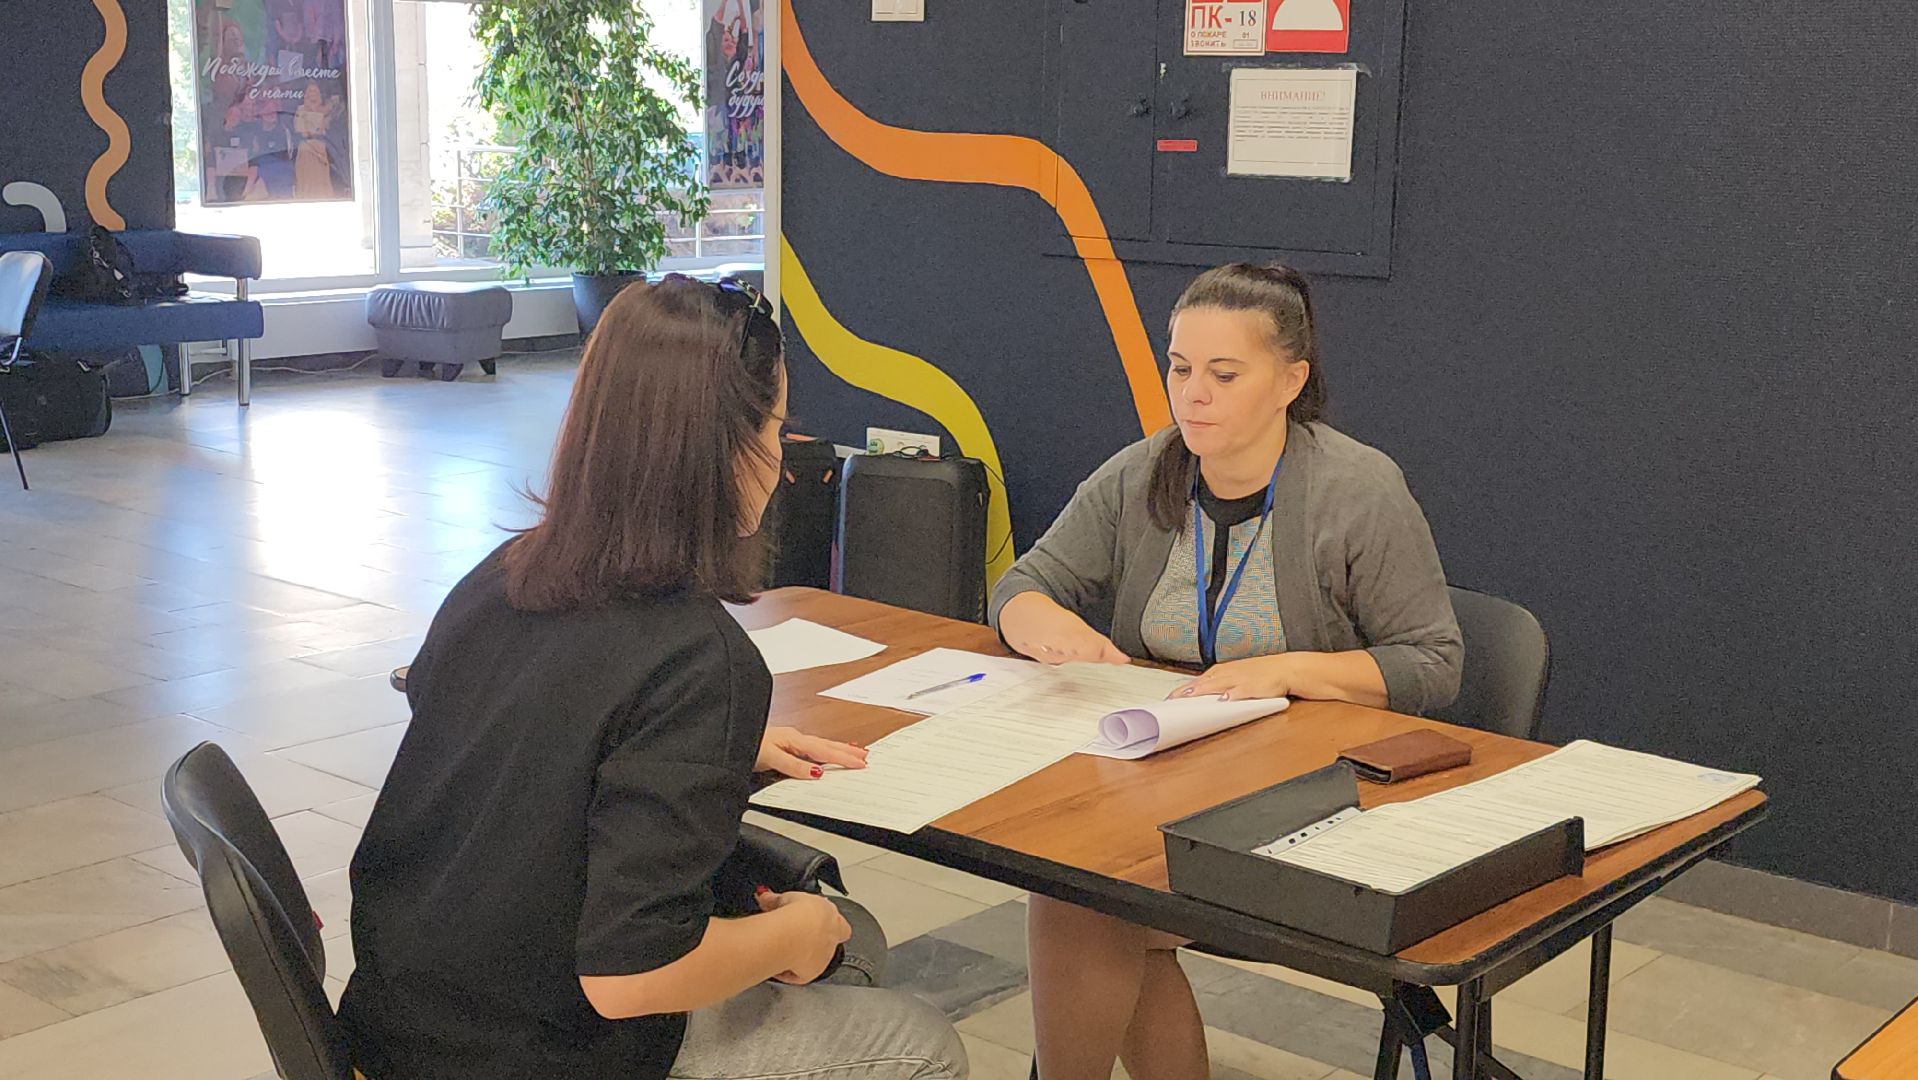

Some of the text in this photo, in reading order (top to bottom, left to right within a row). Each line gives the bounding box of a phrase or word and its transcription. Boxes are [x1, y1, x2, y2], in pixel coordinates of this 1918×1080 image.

[1239, 10, 1257, 27] 18
[201, 56, 283, 87] Побеждай
[262, 87, 304, 99] нами
